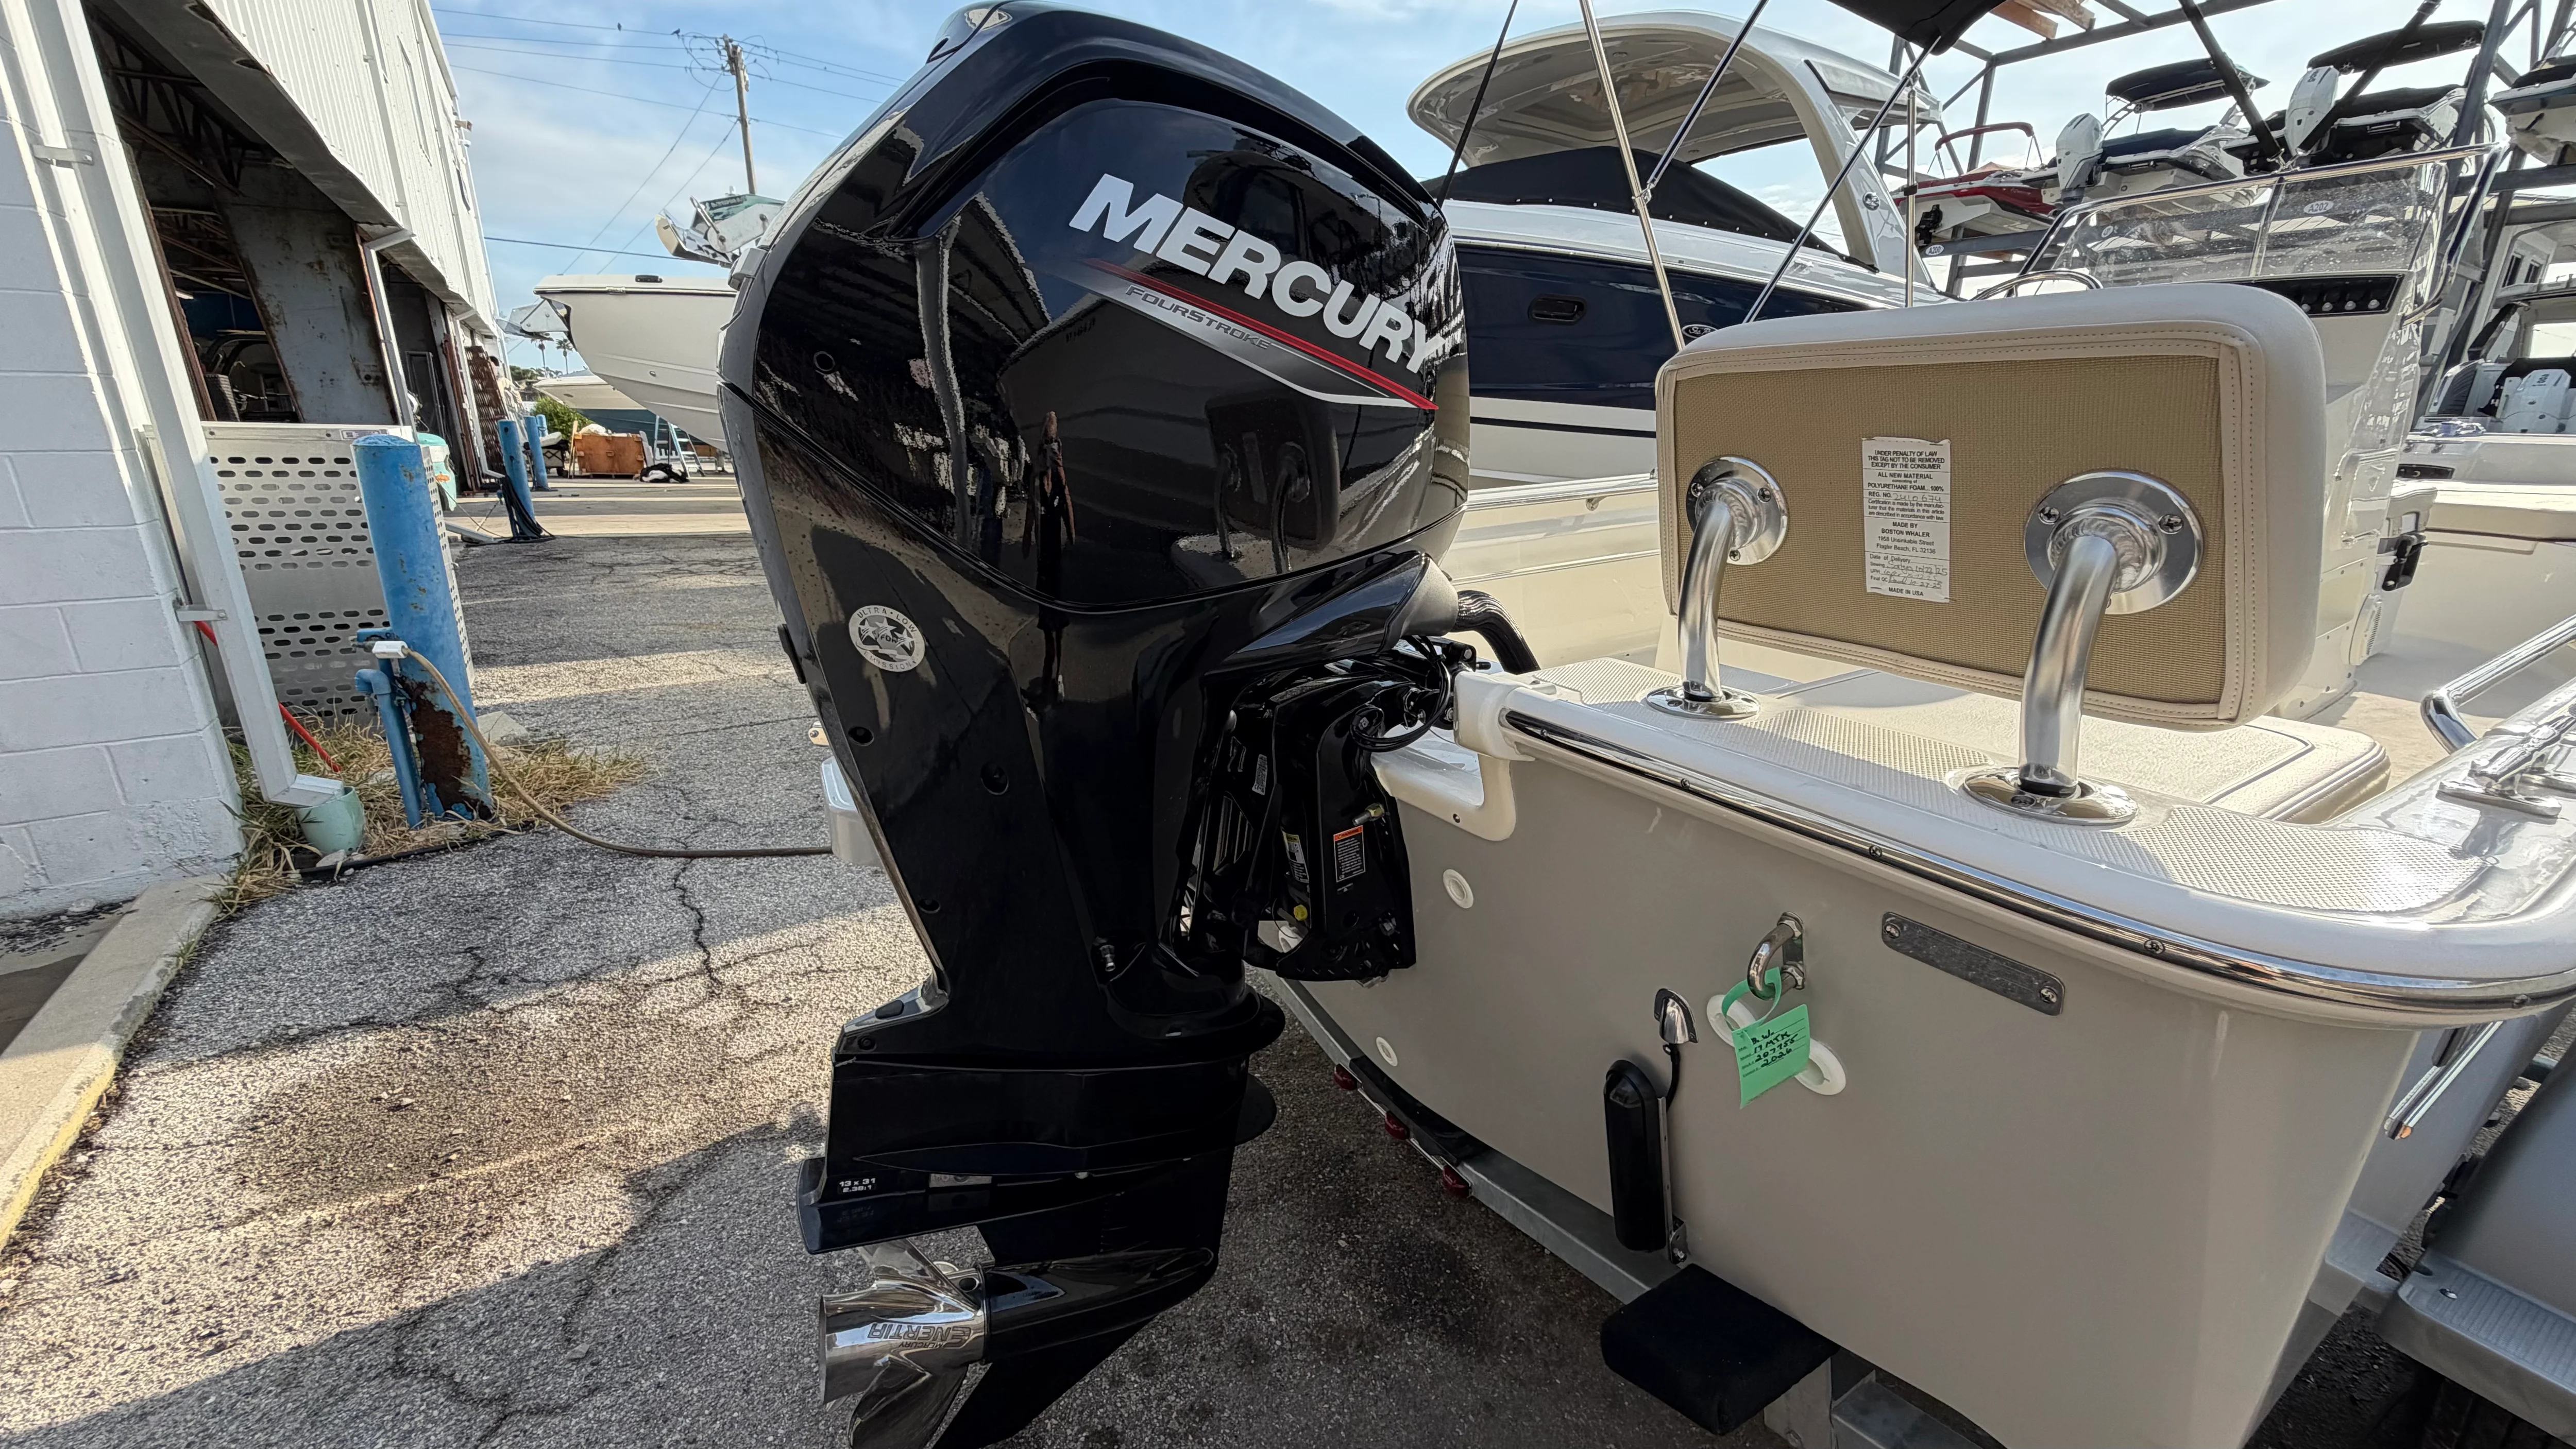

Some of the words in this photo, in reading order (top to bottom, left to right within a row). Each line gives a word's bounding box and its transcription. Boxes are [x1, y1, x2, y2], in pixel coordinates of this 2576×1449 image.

[2308, 202, 2329, 212] A202
[1069, 173, 1446, 373] MERCURY
[1125, 284, 1270, 350] FOURSTROKE
[857, 607, 887, 618] ULTRA
[896, 613, 918, 633] LOW
[1760, 1048, 1792, 1067] 2026
[867, 1323, 972, 1349] ENERTIA
